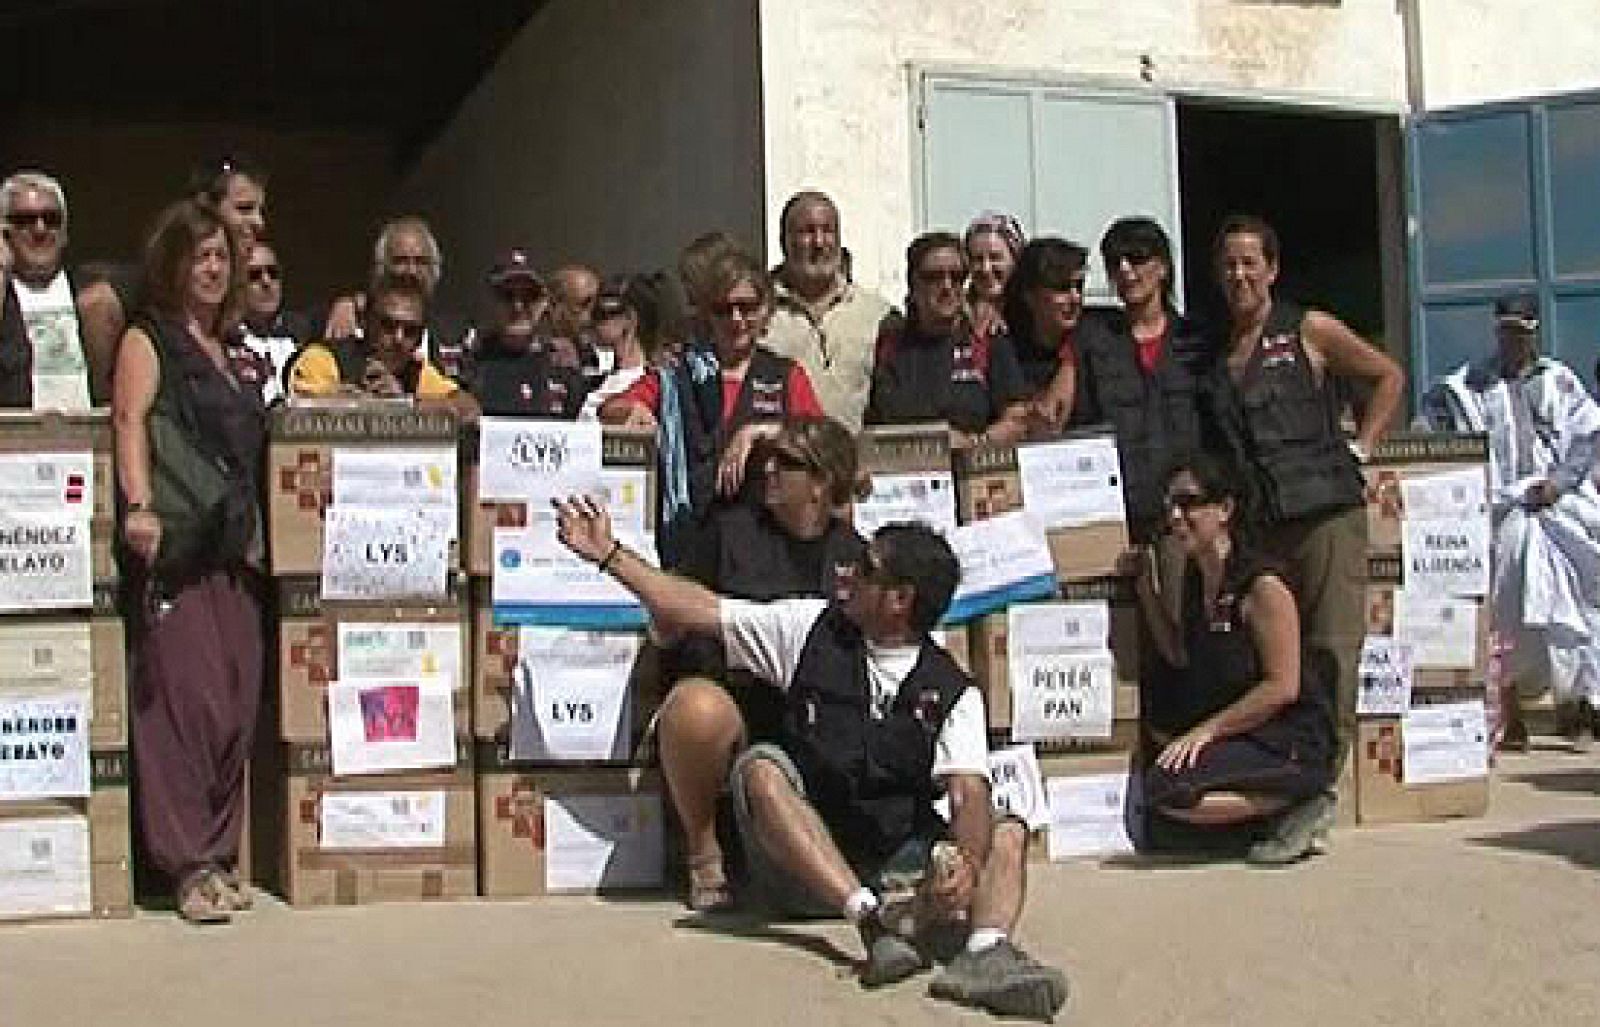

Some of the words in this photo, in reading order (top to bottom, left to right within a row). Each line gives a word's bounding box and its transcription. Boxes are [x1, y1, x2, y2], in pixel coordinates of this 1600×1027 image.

[366, 543, 407, 563] LYS
[1033, 664, 1091, 689] PETER
[551, 702, 595, 723] LYS
[1044, 698, 1082, 719] PAN
